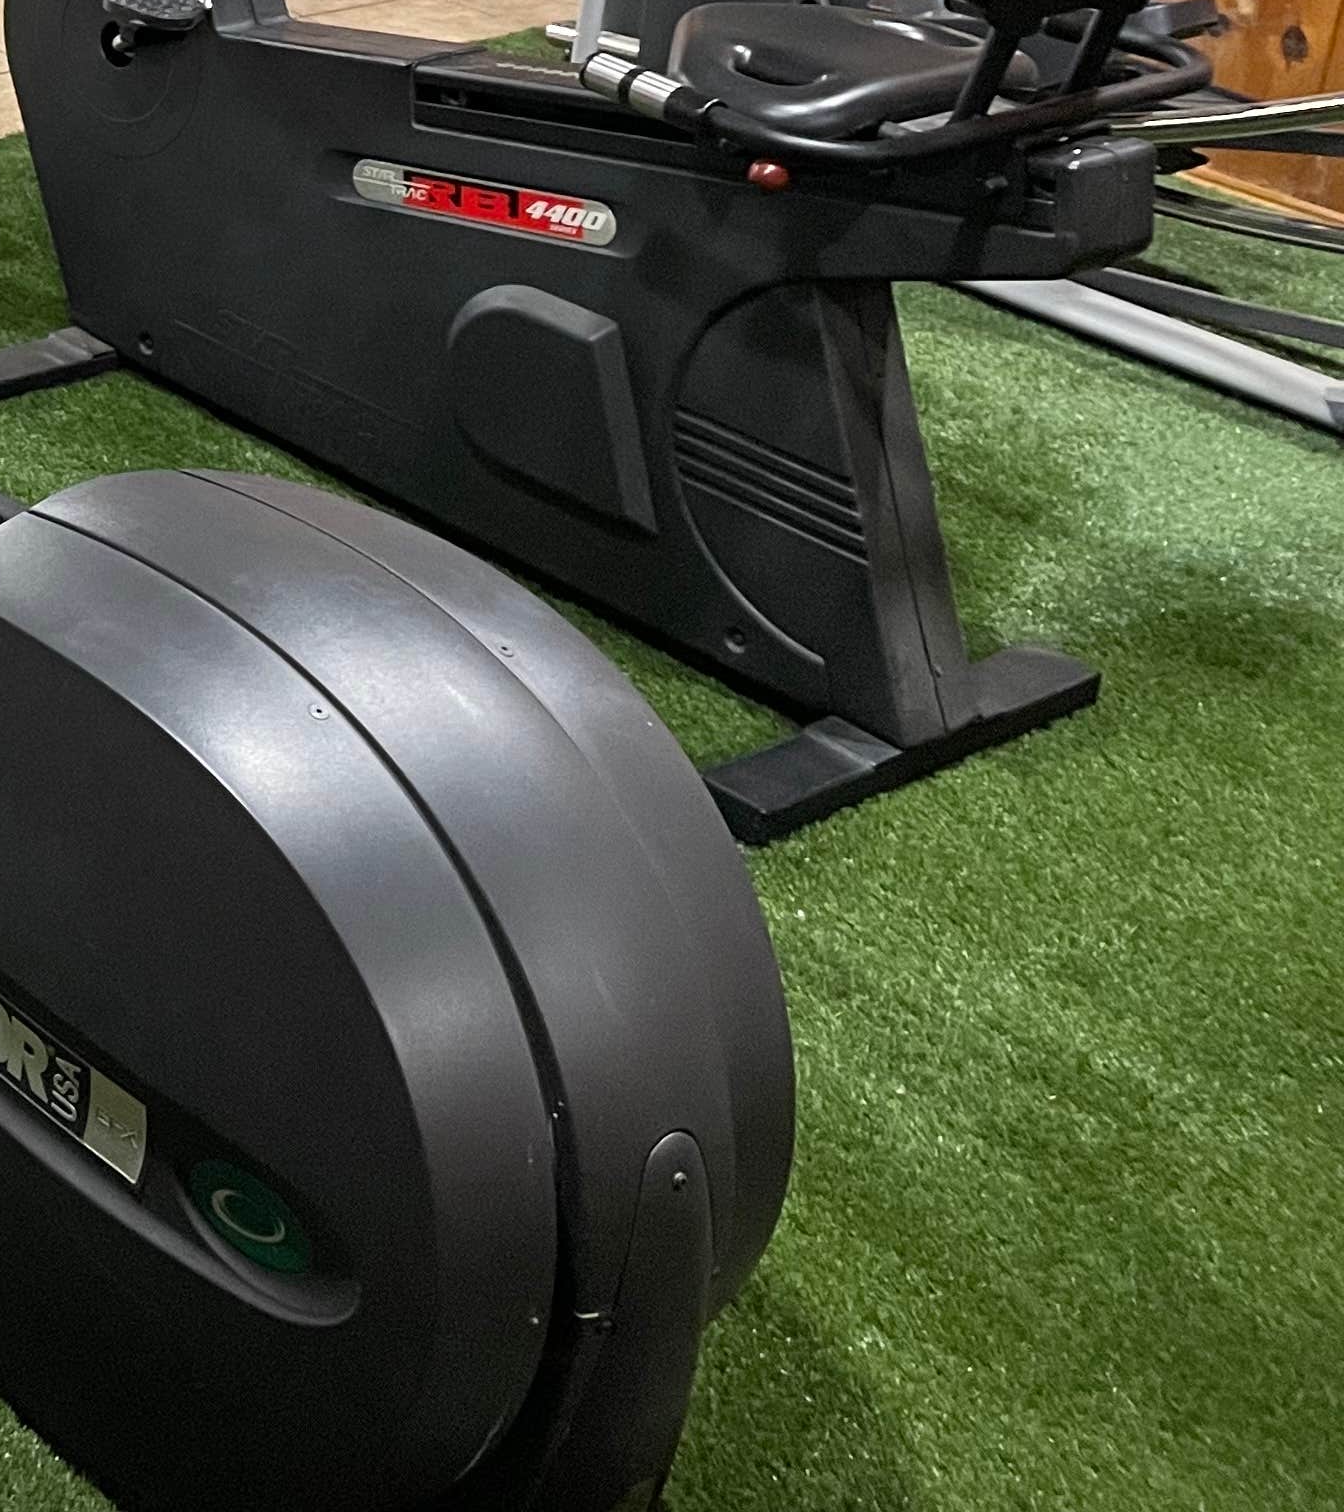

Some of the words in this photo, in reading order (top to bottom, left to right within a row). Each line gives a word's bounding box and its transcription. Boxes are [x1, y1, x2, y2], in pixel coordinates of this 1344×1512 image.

[362, 165, 398, 181] STAR
[389, 184, 429, 201] TRAC
[525, 200, 609, 231] 4400
[51, 1056, 82, 1123] USA
